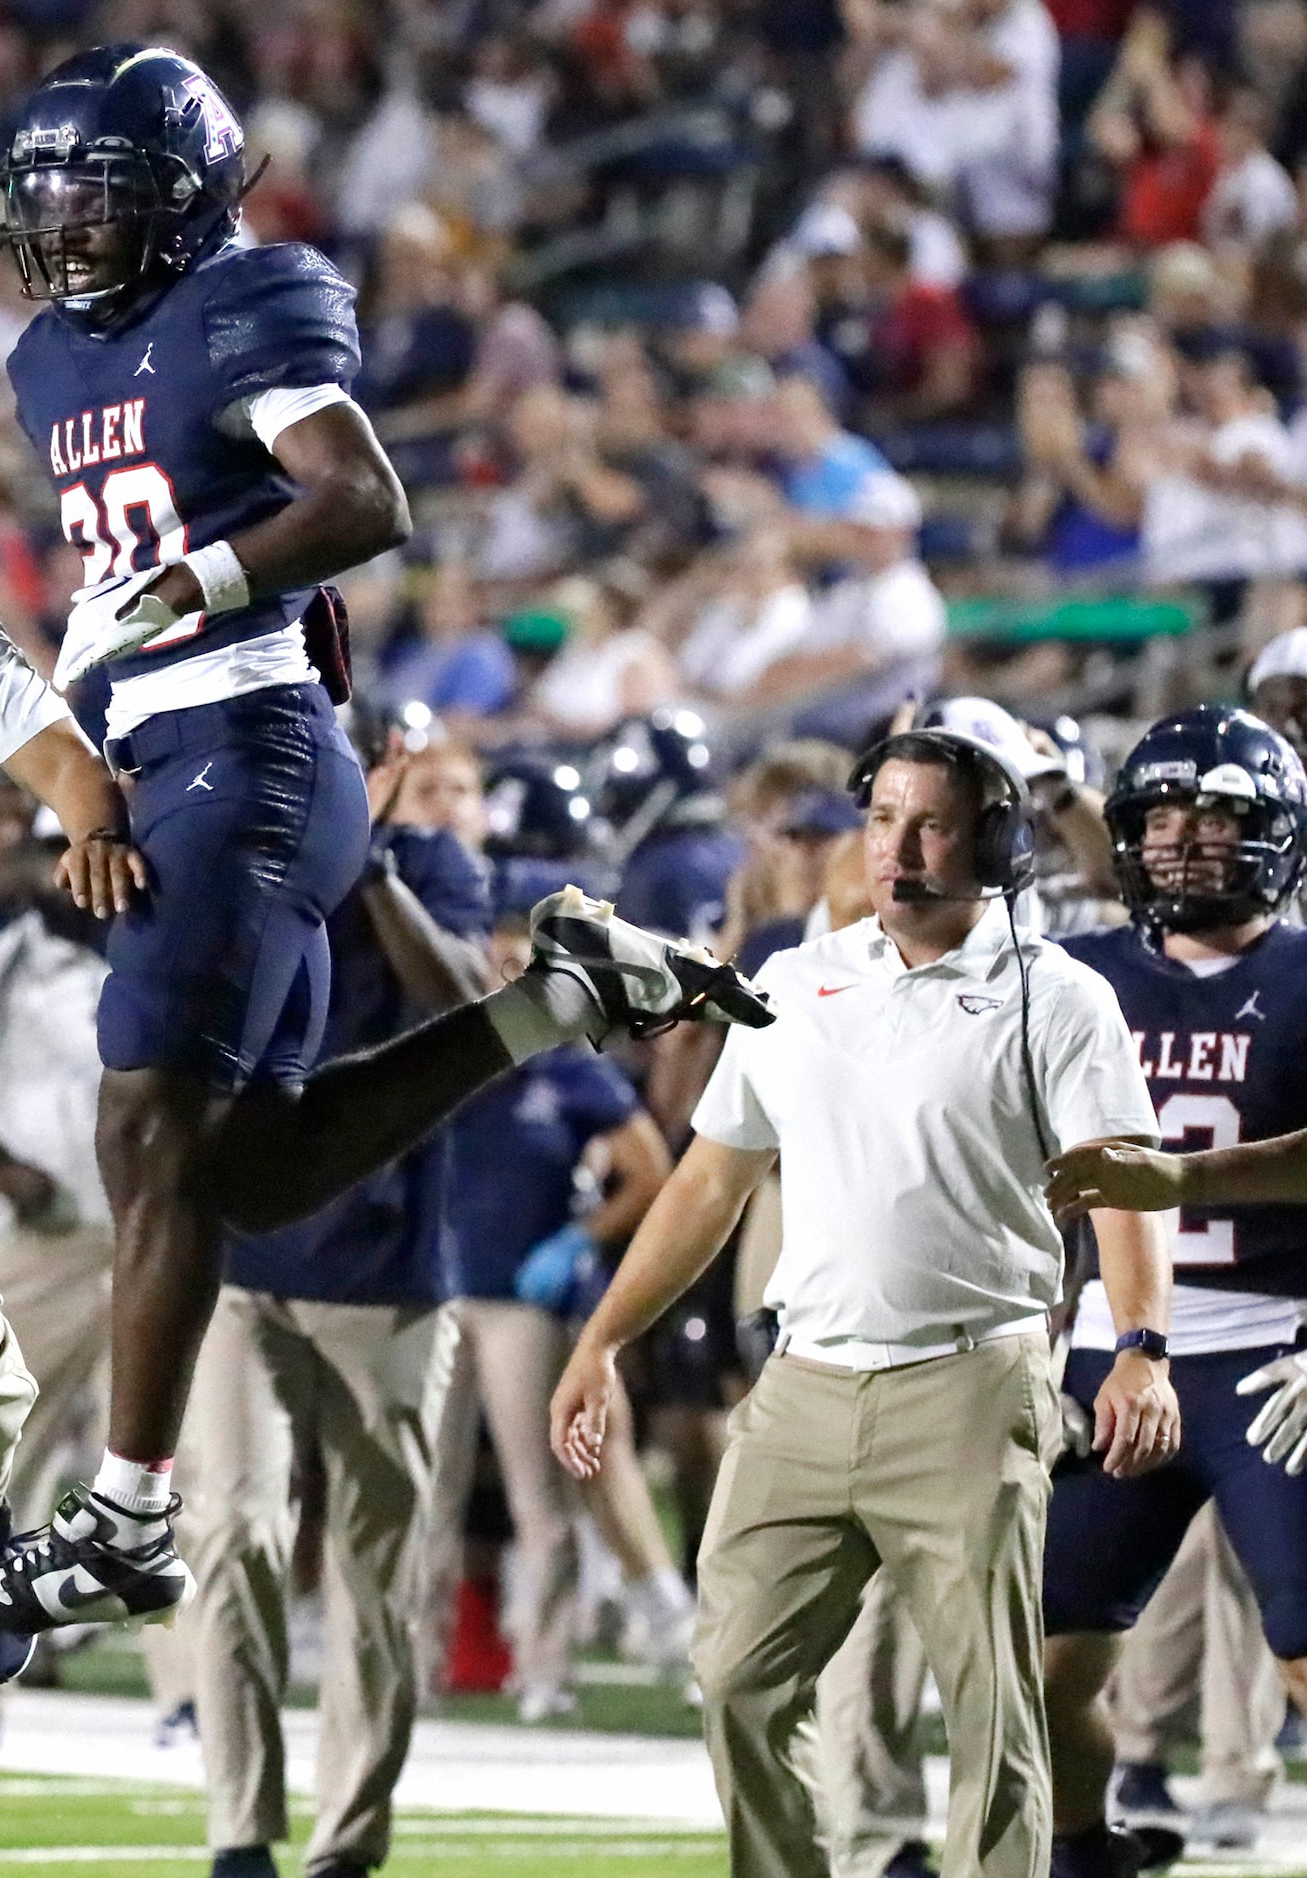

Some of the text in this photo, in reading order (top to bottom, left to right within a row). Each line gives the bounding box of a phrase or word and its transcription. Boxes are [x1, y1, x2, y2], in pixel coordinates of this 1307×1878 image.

[181, 73, 244, 166] A
[50, 397, 145, 477] ALLEN
[1132, 1031, 1251, 1082] LLEN
